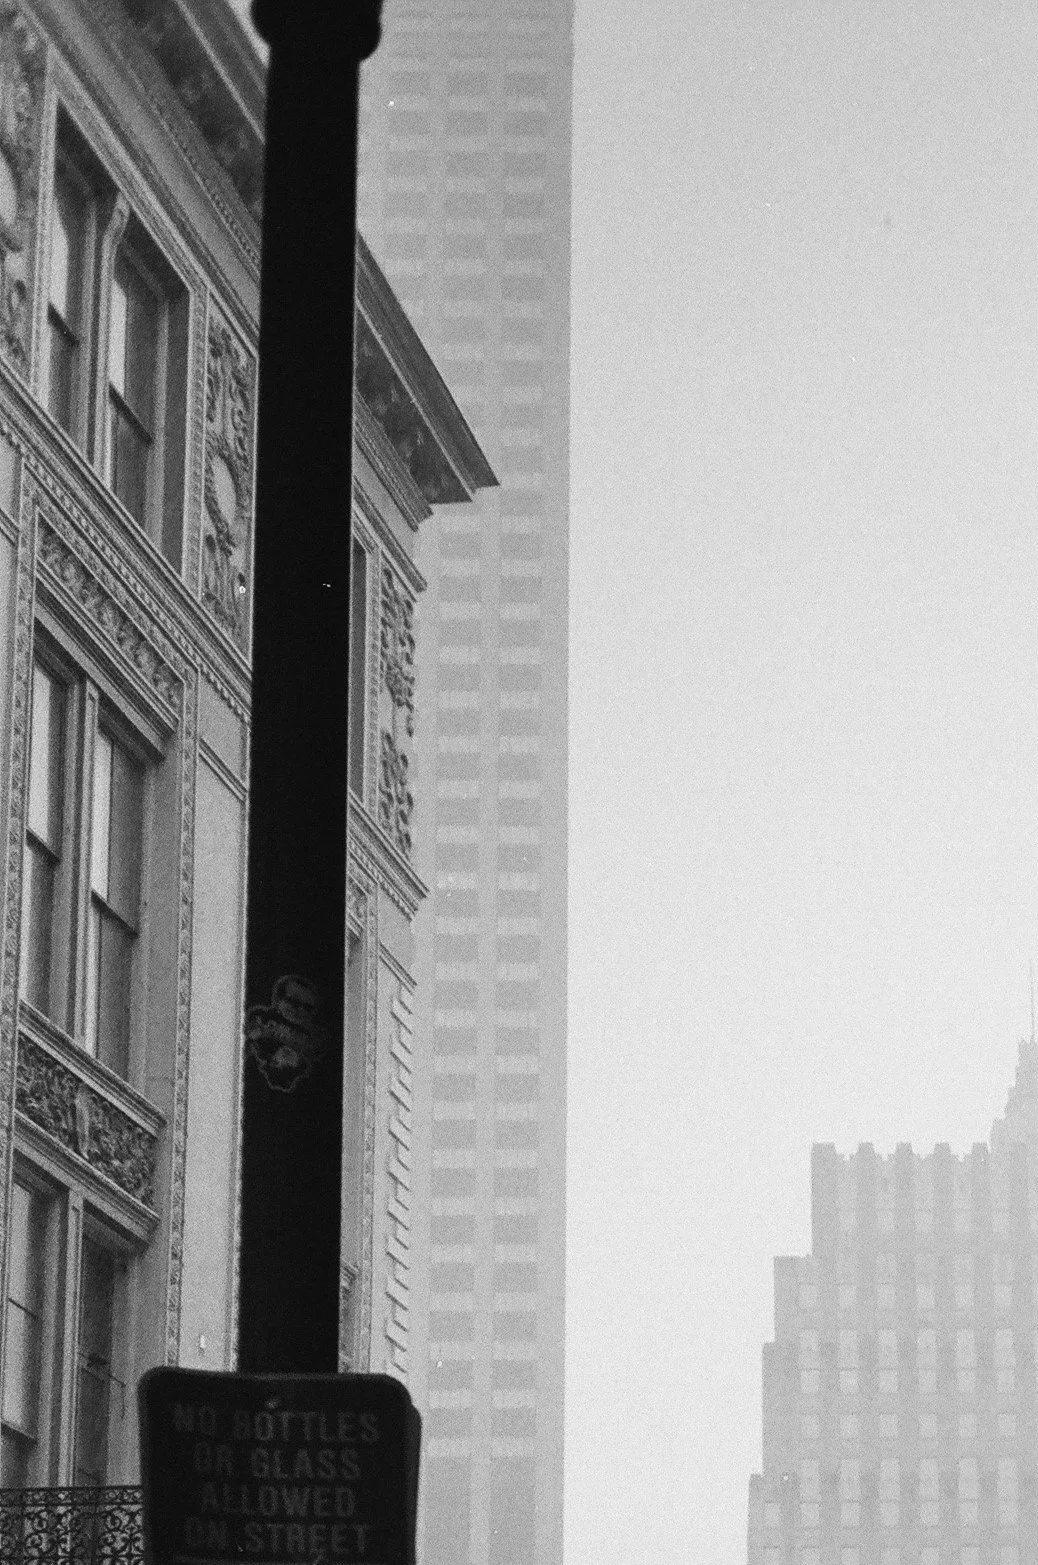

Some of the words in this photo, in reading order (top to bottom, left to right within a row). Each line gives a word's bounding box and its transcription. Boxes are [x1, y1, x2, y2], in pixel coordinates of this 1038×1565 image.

[172, 1402, 217, 1435] NO
[233, 1409, 381, 1443] BOTTLES
[193, 1442, 233, 1475] OR
[250, 1447, 362, 1480] GLASS
[201, 1482, 357, 1517] ALLOWED
[184, 1516, 229, 1550] ON
[244, 1521, 370, 1554] STREET
